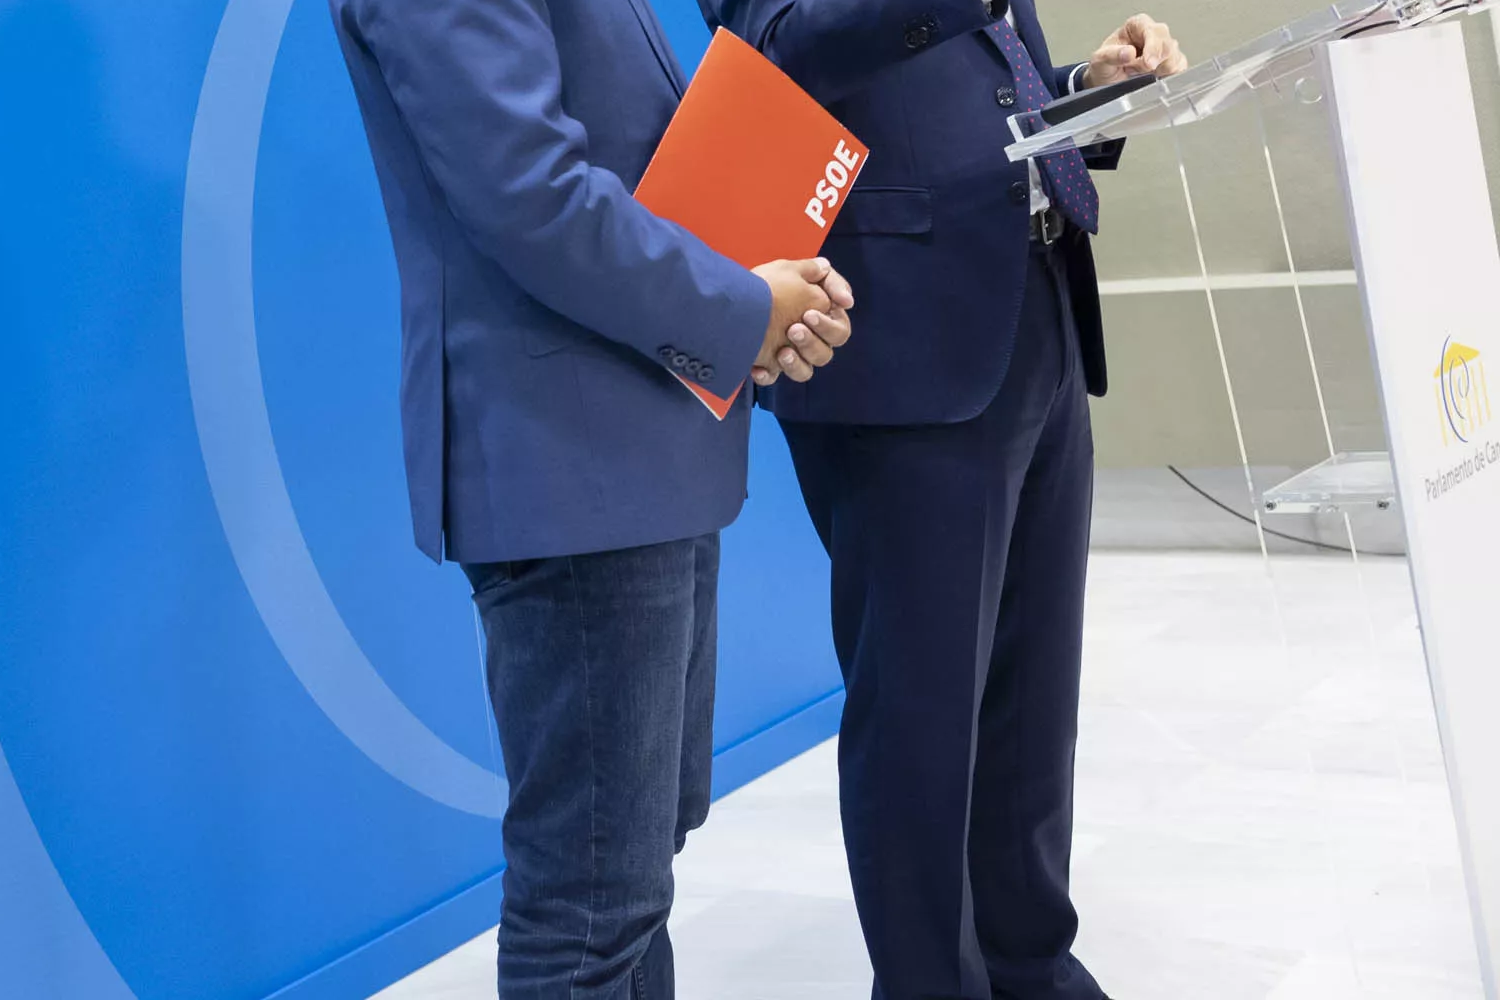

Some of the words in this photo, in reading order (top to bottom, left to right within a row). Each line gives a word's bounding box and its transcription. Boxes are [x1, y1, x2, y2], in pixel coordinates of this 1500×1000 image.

[804, 138, 860, 229] PSOE
[1424, 453, 1474, 502] Parlamento
[1474, 446, 1486, 472] de
